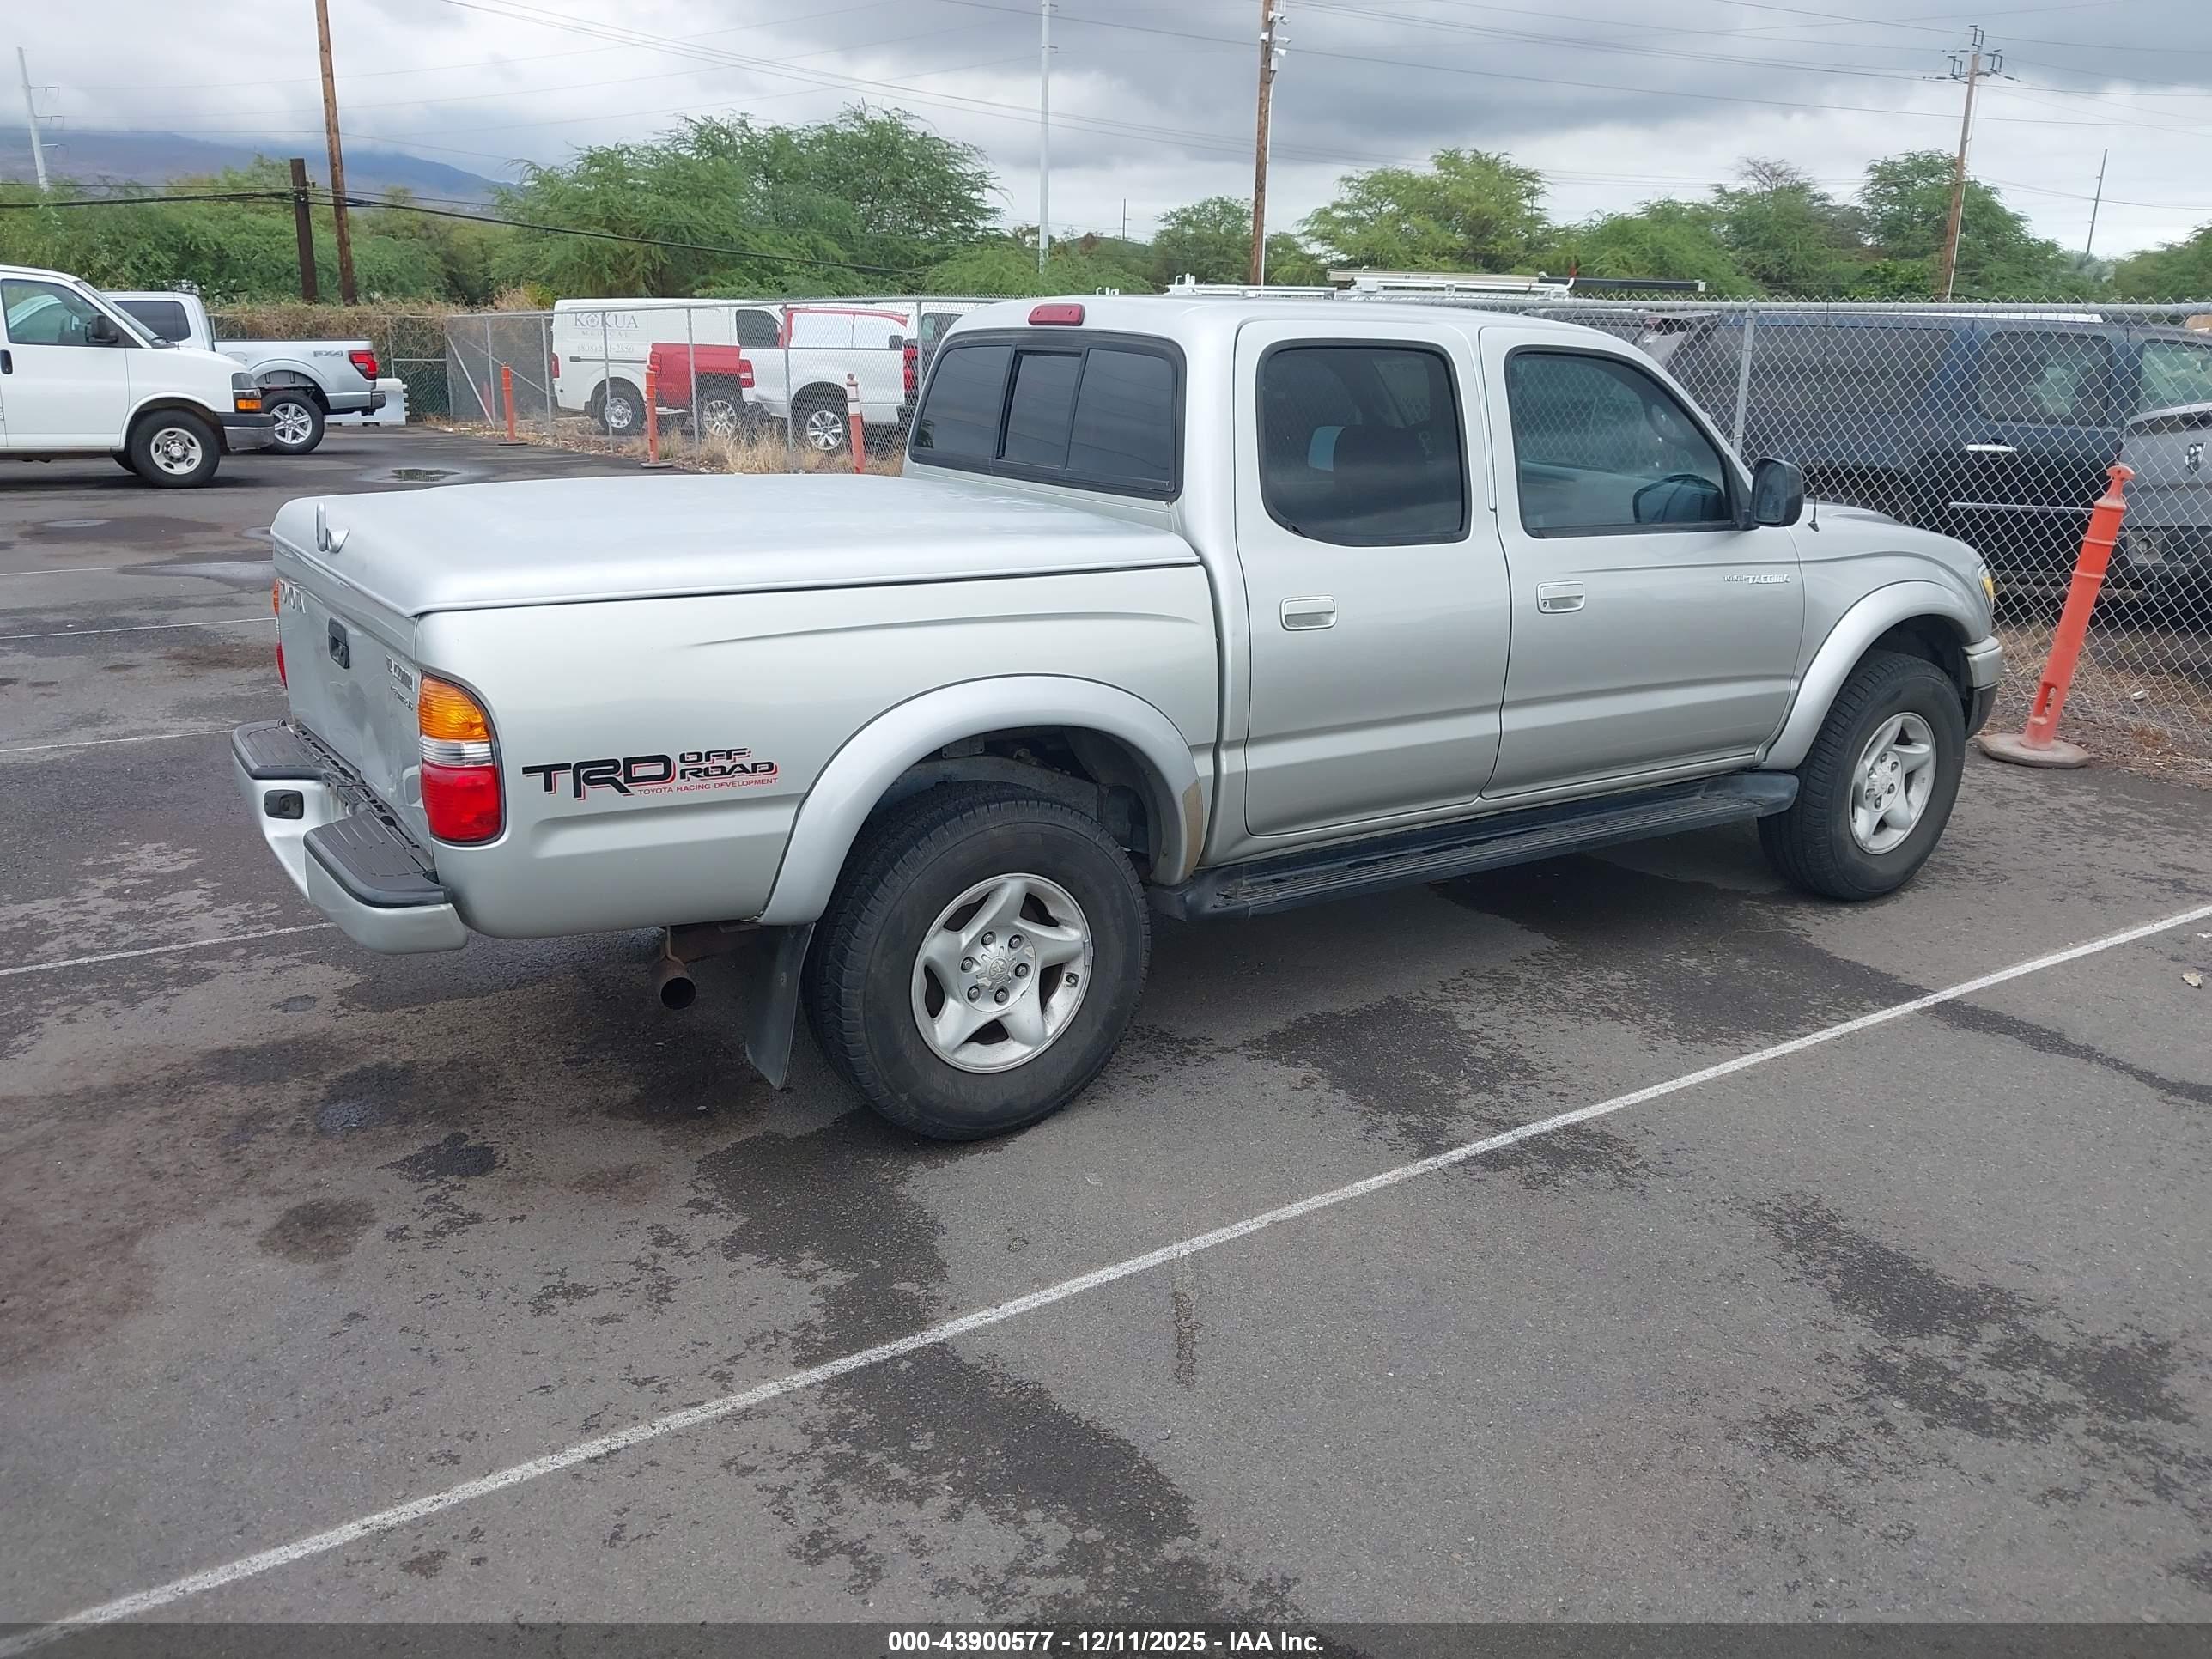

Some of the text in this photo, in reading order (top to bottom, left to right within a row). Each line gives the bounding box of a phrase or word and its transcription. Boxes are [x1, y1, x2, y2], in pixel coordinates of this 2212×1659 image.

[574, 312, 638, 328] KOKUA
[581, 330, 629, 338] MEDCAL
[679, 748, 752, 767] OFF
[521, 754, 677, 801] TRD
[679, 761, 778, 782] ROAD
[637, 777, 779, 796] TOYOTA RACING DEVELOPMENT
